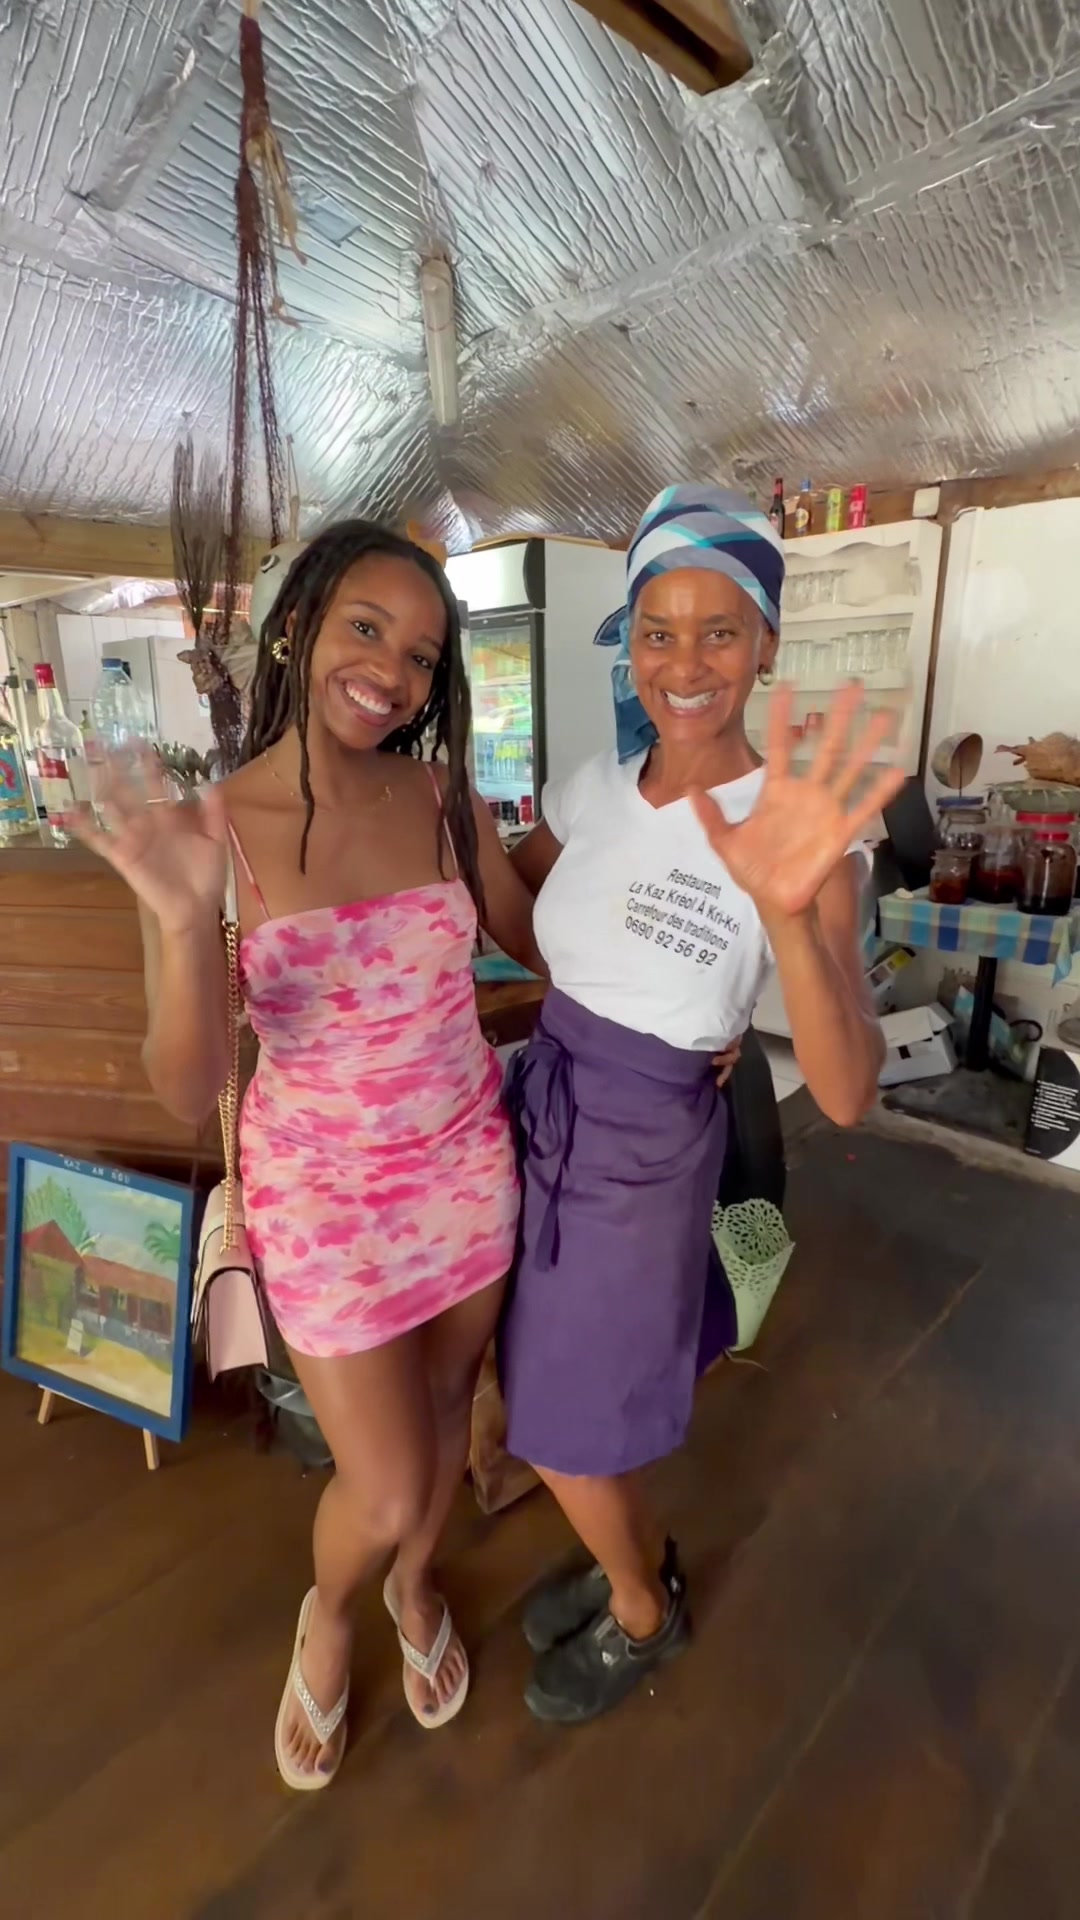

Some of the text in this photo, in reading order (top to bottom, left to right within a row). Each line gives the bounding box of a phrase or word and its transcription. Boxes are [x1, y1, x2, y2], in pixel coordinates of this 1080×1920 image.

[629, 881, 643, 894] La
[644, 883, 665, 900] Kaz
[666, 889, 697, 912] Kréol
[707, 904, 741, 936] Kri-Kri
[667, 869, 721, 899] Restaurant
[625, 916, 718, 966] 0690 92 56 92
[627, 898, 729, 951] Carrefour des traditions
[63, 1159, 80, 1171] KAZ
[92, 1167, 104, 1176] AN
